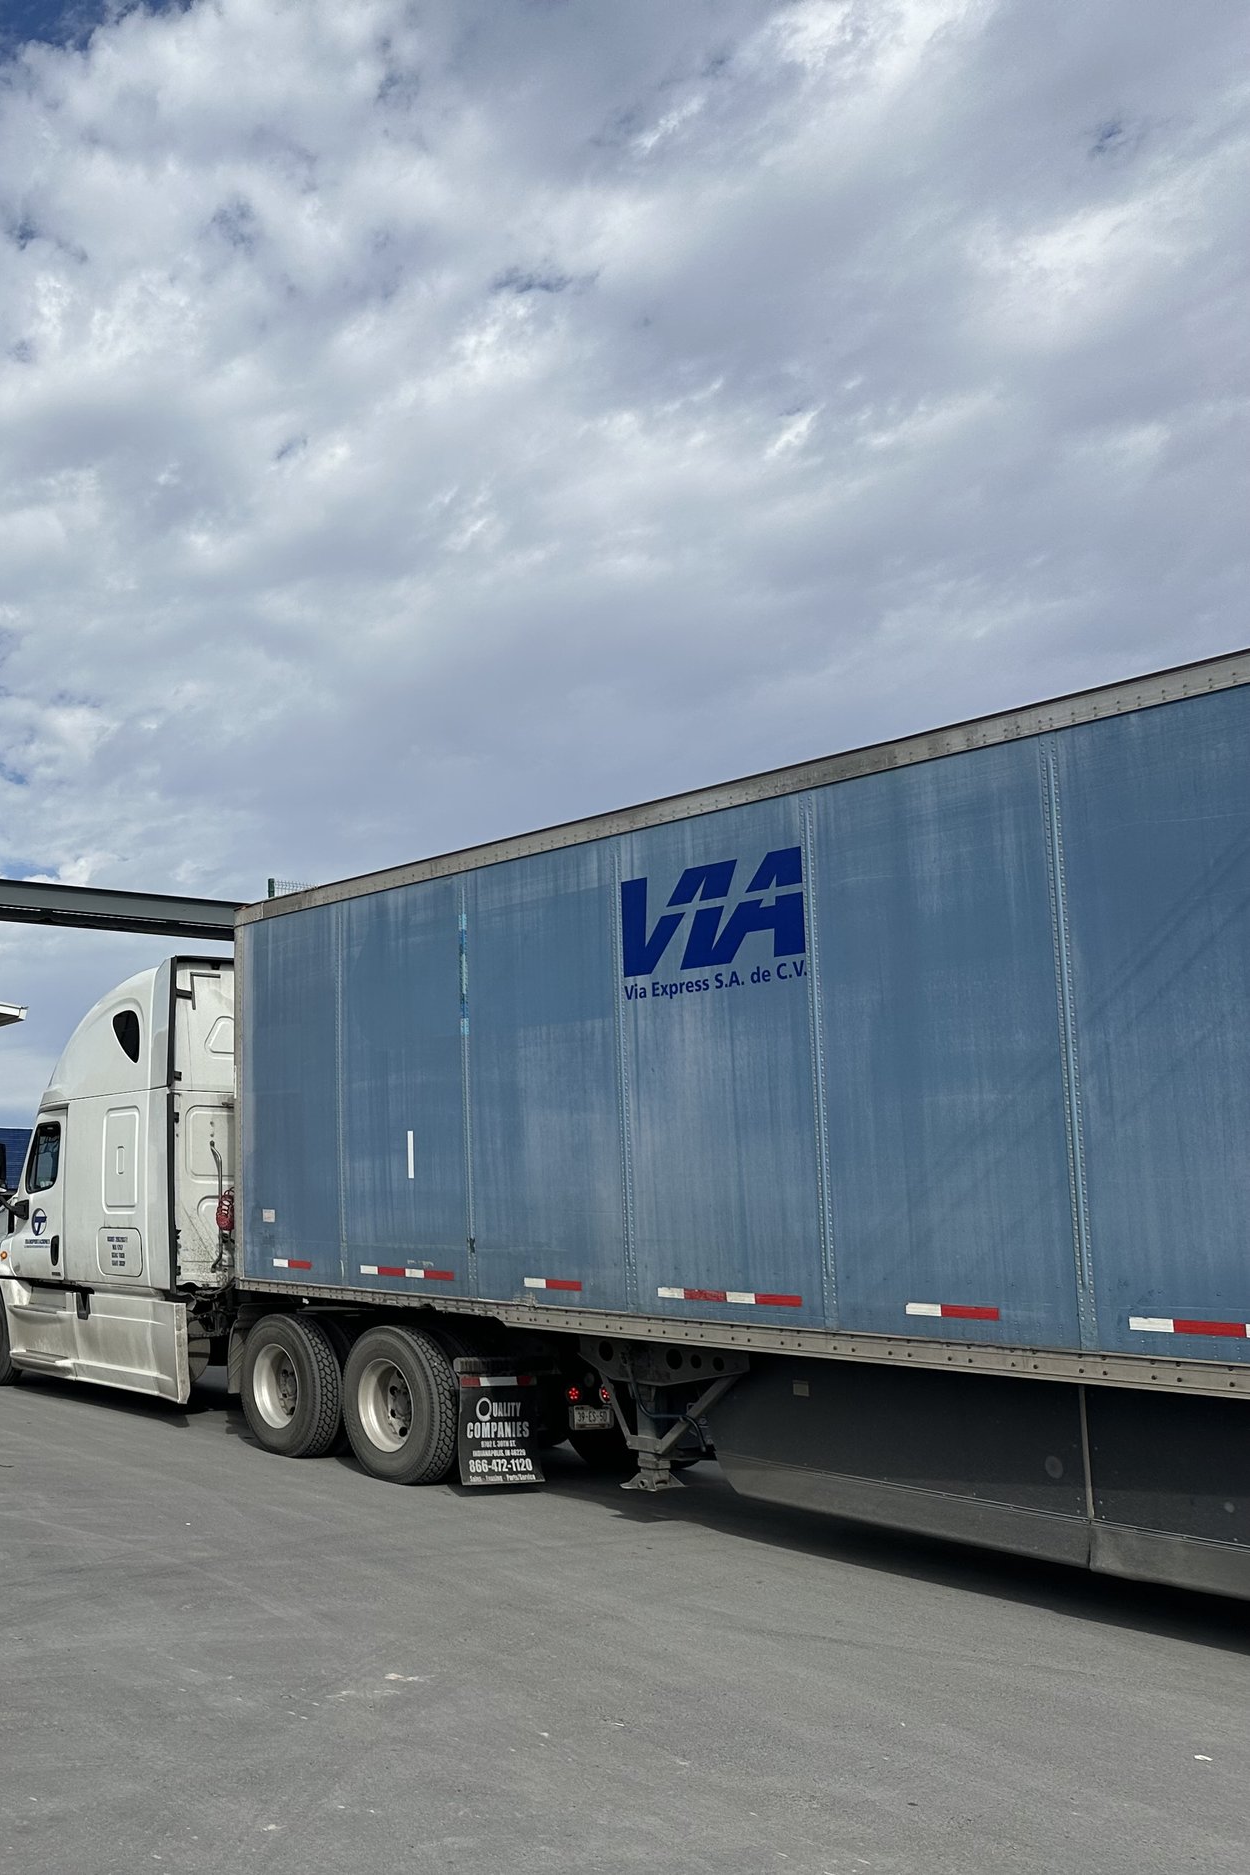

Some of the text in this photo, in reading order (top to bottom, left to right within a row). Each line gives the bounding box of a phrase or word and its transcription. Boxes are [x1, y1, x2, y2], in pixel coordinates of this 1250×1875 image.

[621, 846, 806, 978] VIA
[624, 960, 807, 1001] Via Express S.A. de C.V.
[466, 1421, 530, 1438] COMPANIES
[469, 1458, 533, 1472] 866-472-1120
